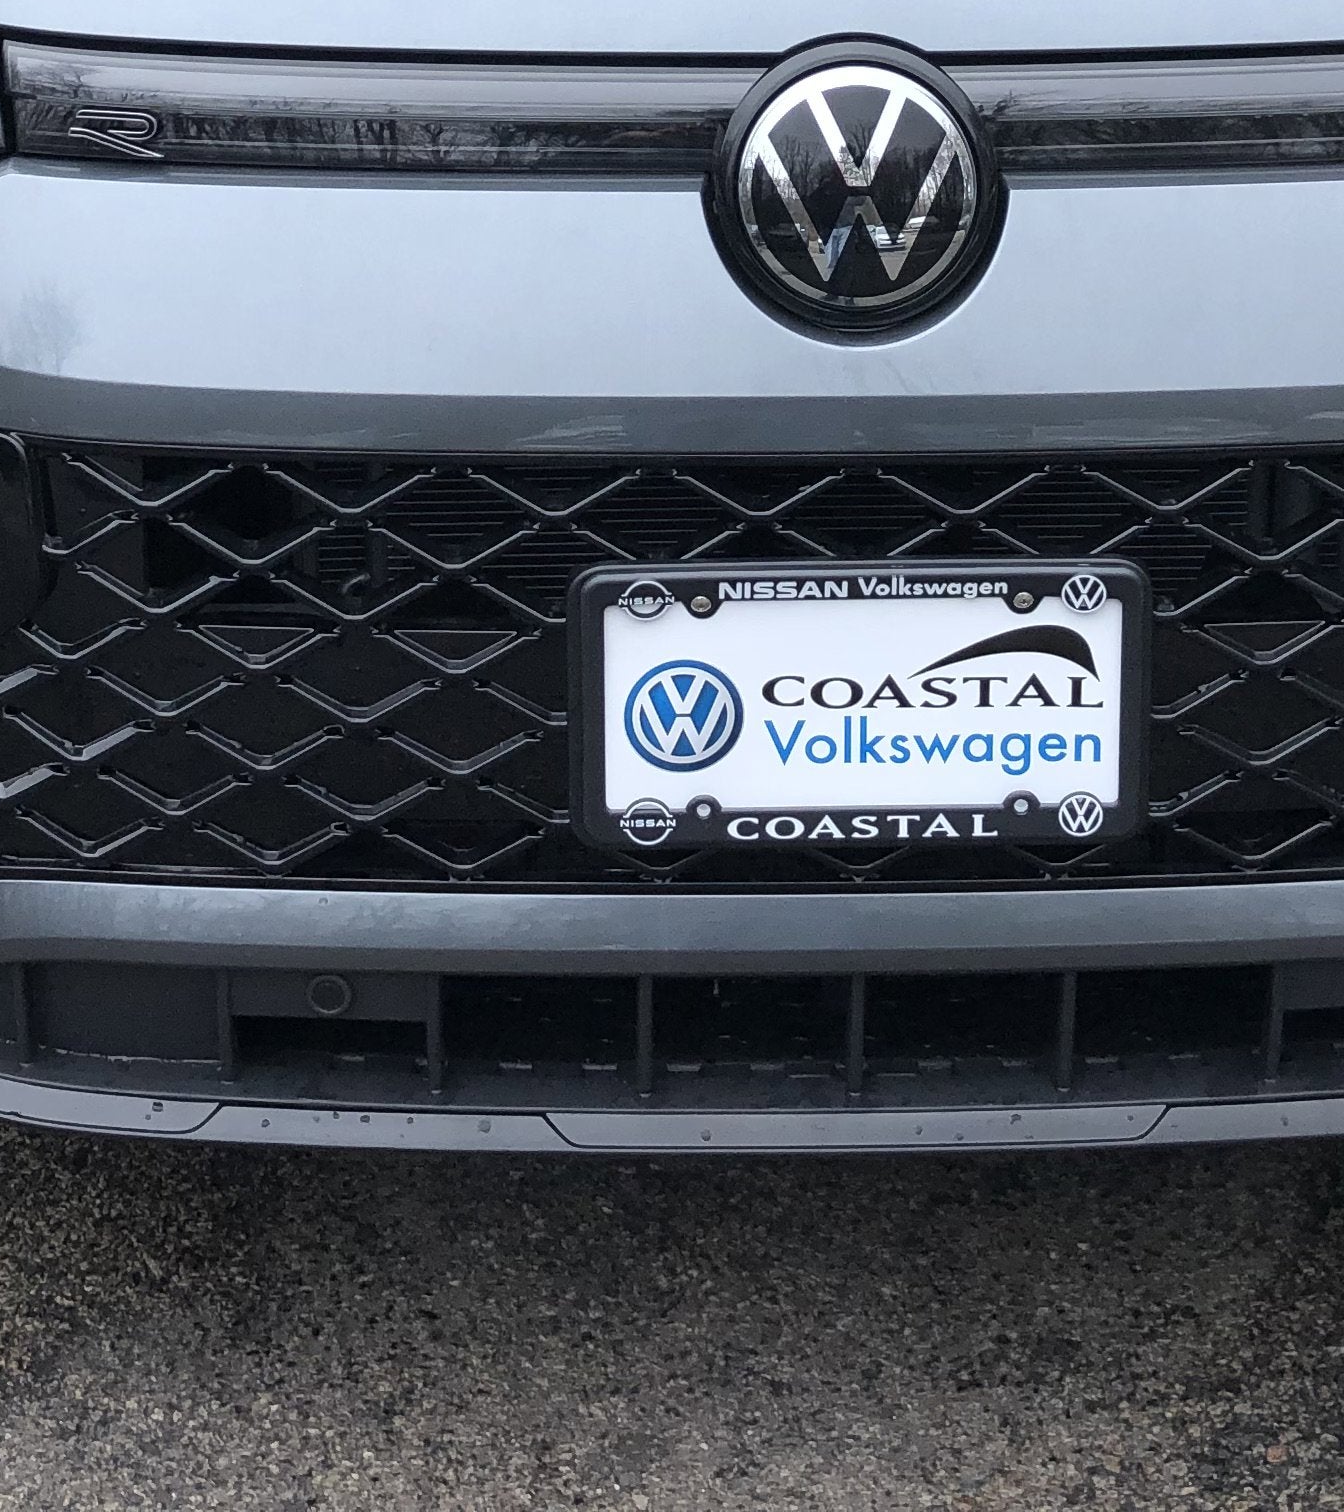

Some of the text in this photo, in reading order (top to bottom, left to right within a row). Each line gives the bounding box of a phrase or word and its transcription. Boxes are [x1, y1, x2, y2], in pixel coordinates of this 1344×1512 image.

[718, 575, 1009, 599] NISSAN Volkswagen
[617, 595, 677, 607] NISSAN
[761, 673, 1104, 709] COASTAL
[763, 716, 1102, 776] Volkswagen
[619, 818, 677, 829] NISSAN
[727, 813, 998, 840] COASTAL
